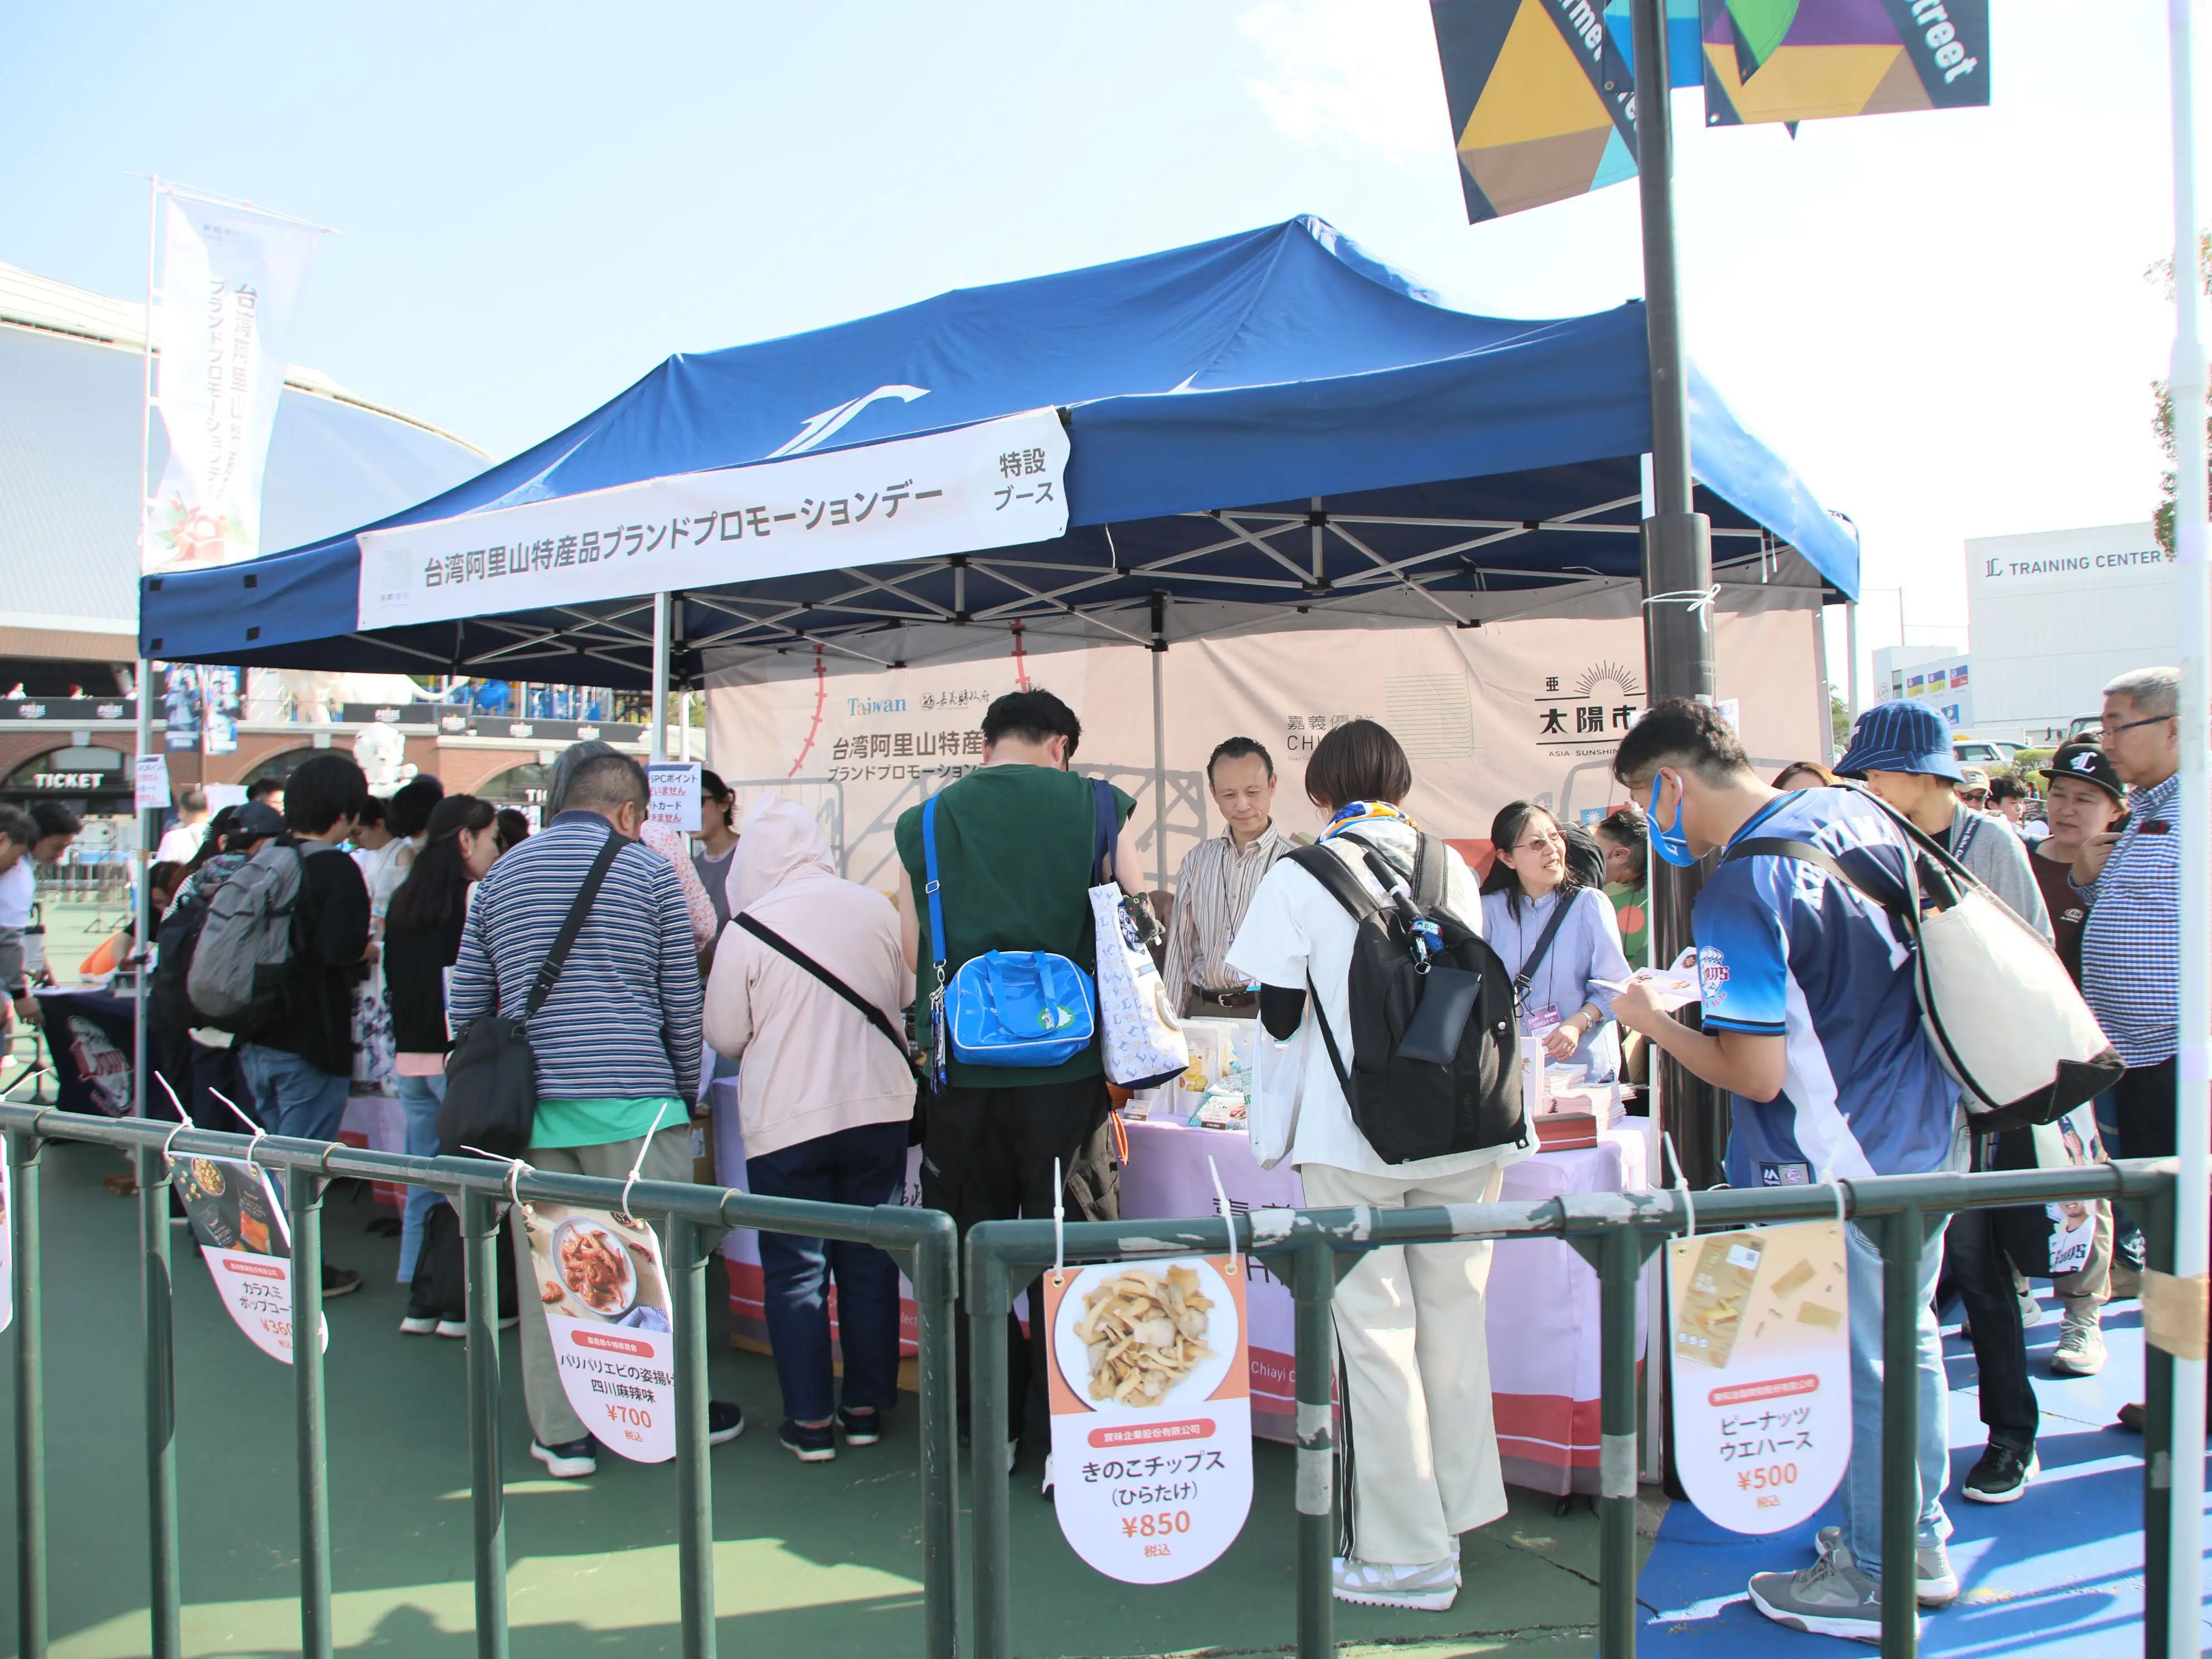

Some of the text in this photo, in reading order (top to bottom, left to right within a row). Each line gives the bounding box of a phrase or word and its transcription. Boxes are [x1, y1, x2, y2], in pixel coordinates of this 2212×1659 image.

[1901, 0, 1978, 85] treet
[999, 447, 1046, 478] 特設
[994, 482, 1054, 512] ブース
[425, 478, 943, 588] 台湾阿里山特産品ブランドプロモーションデー
[2009, 556, 2090, 576] TRAINING
[2095, 550, 2162, 568] CENTER
[1545, 676, 1559, 692] 亜
[847, 697, 907, 716] Taiwan
[34, 773, 105, 789] TICKET
[1533, 1018, 1555, 1027] GUEST-C
[242, 1280, 283, 1299] カラスミ
[239, 1295, 293, 1314] ポップコー
[1251, 1361, 1286, 1382] Chiayi
[591, 1379, 657, 1404] 四川麻辣味
[605, 1404, 653, 1428] ¥700
[1721, 1406, 1811, 1436] ピーナッツ
[624, 1429, 643, 1443] 税込
[1719, 1430, 1813, 1462] ウエハース
[1081, 1449, 1226, 1483] きのこチップス
[1737, 1462, 1798, 1491] ¥500
[1112, 1480, 1198, 1507] (ひらたけ)
[1122, 1510, 1191, 1539] ¥850
[1143, 1543, 1171, 1558] 税込
